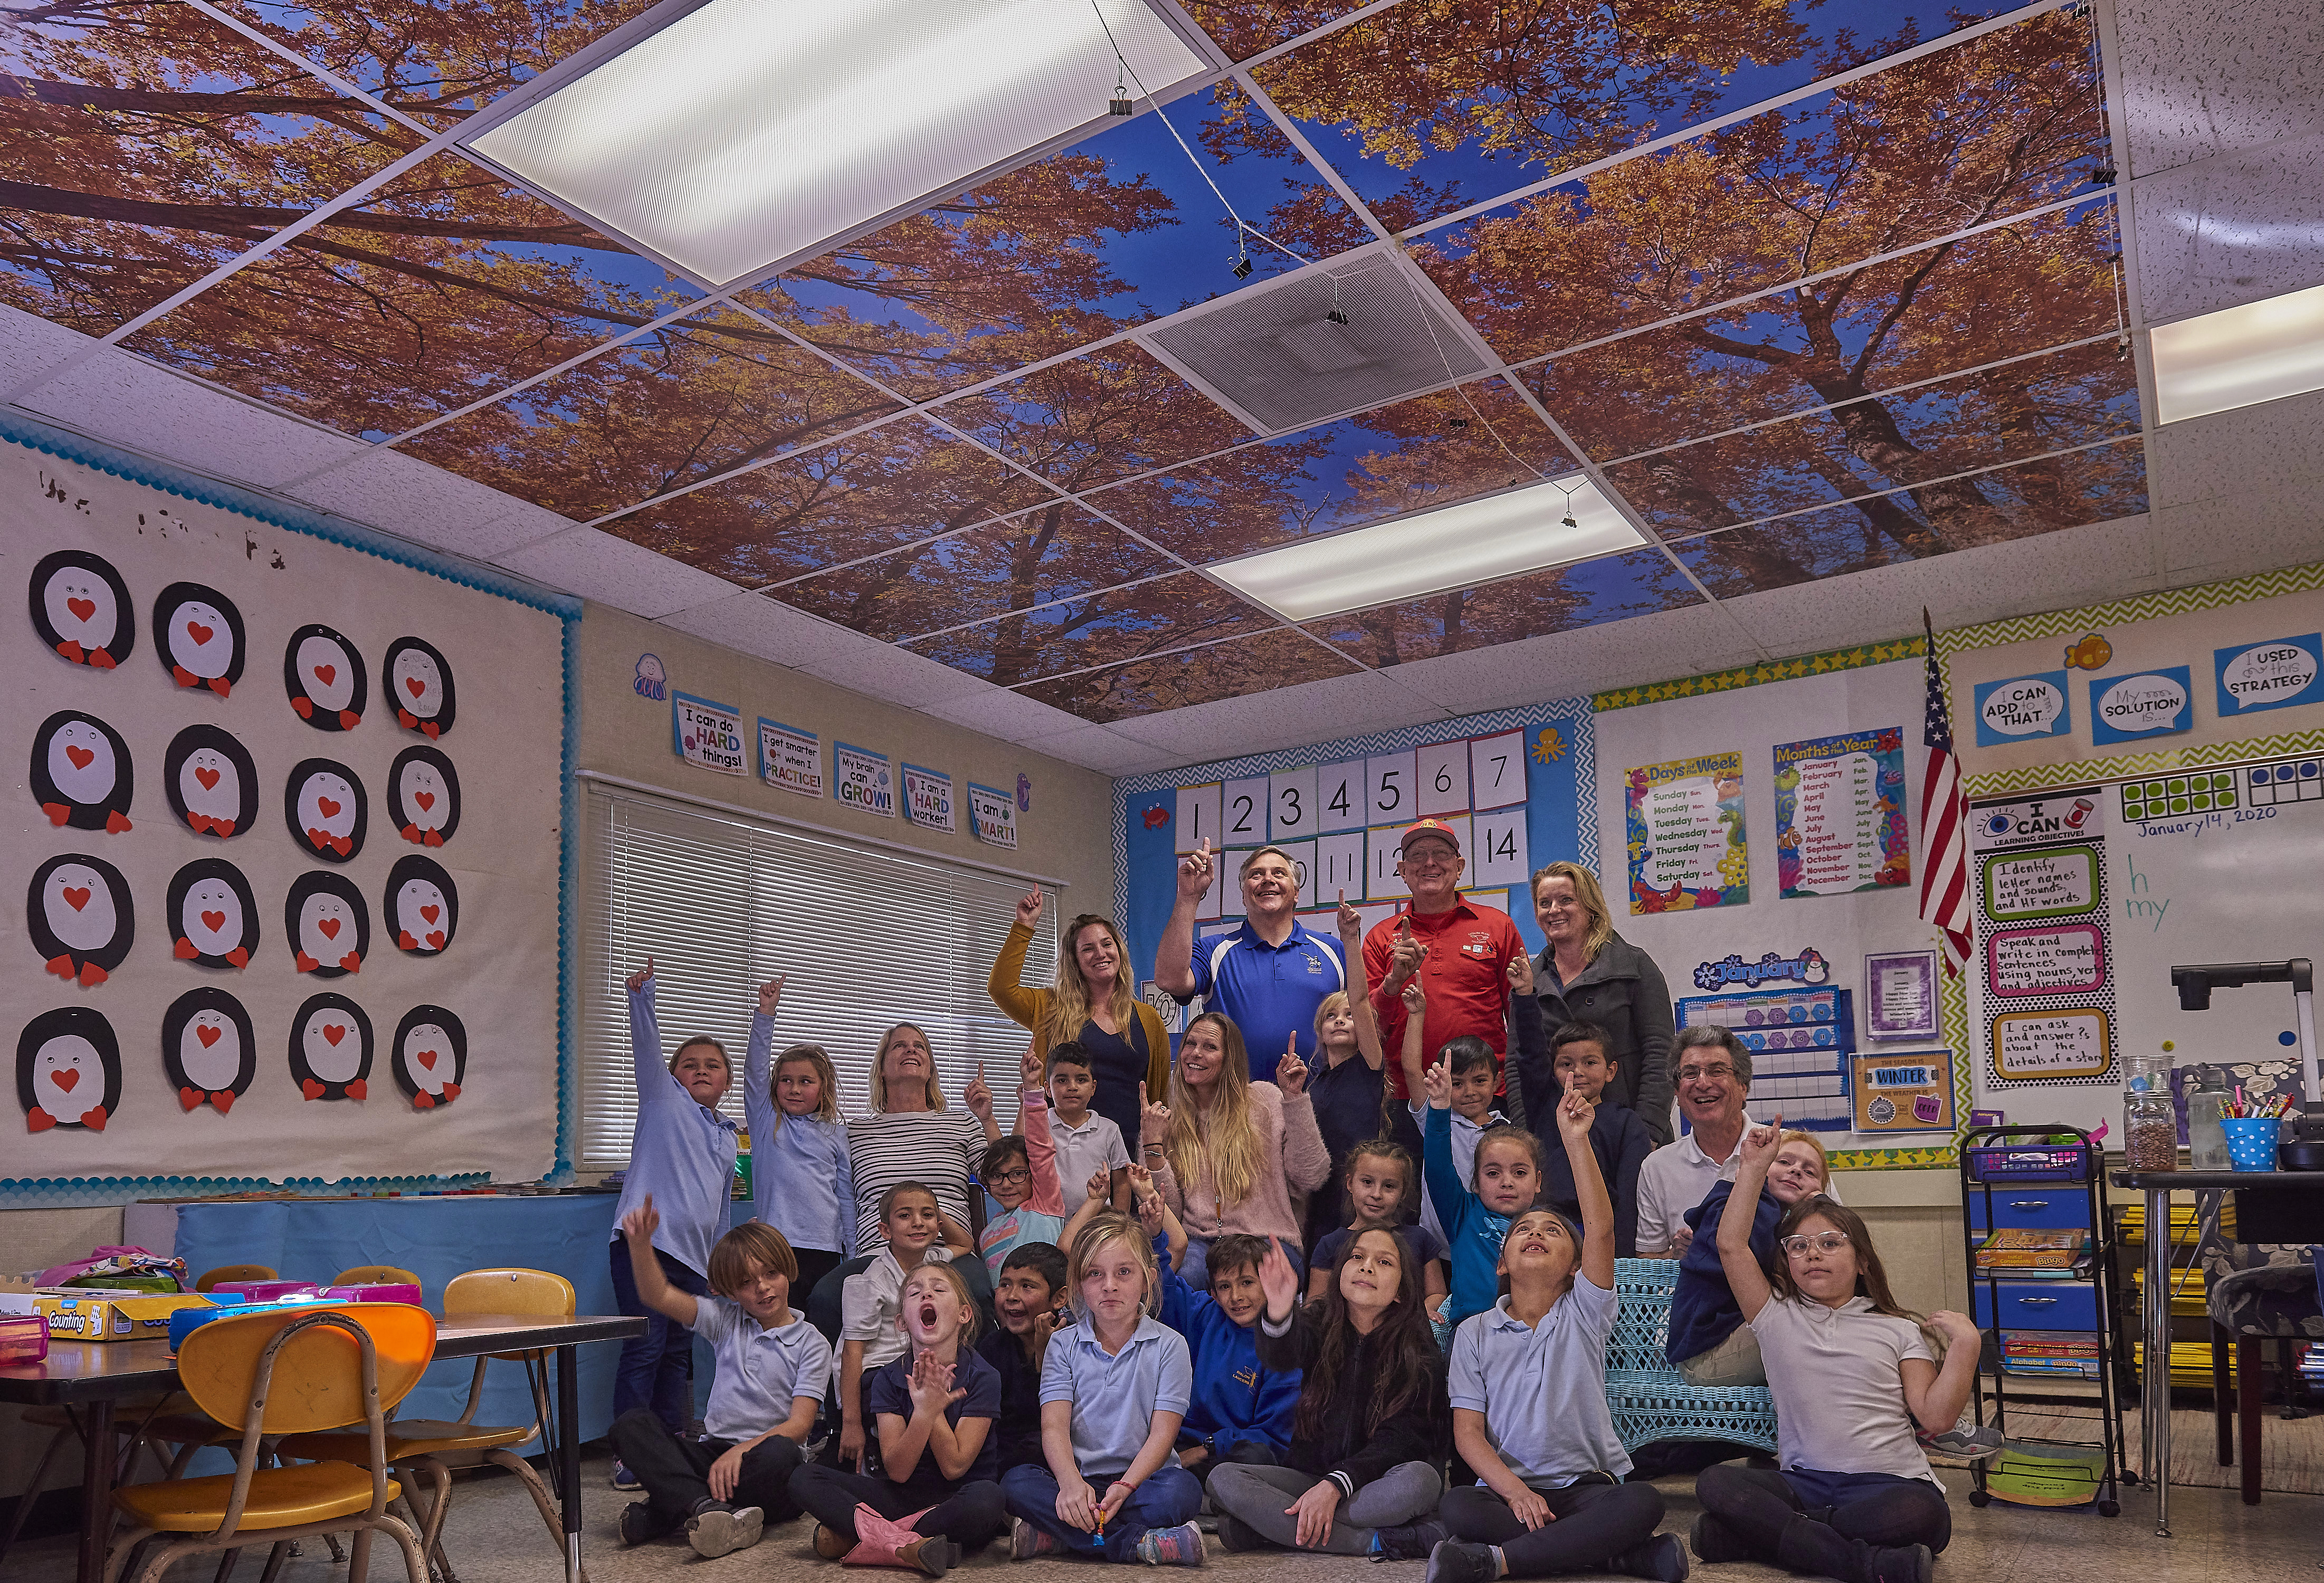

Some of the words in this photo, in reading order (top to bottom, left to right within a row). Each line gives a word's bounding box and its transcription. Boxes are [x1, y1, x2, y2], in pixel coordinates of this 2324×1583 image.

[2245, 653, 2251, 665] I
[2258, 649, 2298, 663] USED
[2271, 661, 2300, 675] this
[2230, 673, 2312, 693] STRATEGY
[2002, 691, 2006, 702] I
[2013, 686, 2046, 701] CAN
[2117, 690, 2140, 705] My
[1986, 703, 2018, 717] ADD
[2022, 700, 2035, 711] to
[2106, 698, 2179, 717] SOLUTION
[686, 709, 692, 721] I
[697, 714, 716, 728] can
[720, 719, 733, 732] do
[2001, 710, 2051, 726] THAT...
[697, 727, 740, 751] HARD
[764, 734, 768, 743] I
[770, 738, 784, 748] get
[786, 743, 817, 756] smarter
[702, 748, 742, 767] things!
[1776, 745, 1830, 762] Months
[1842, 738, 1879, 752] Year
[785, 756, 805, 768] when
[807, 760, 812, 769] I
[843, 757, 854, 770] My
[856, 761, 875, 774] brain
[1650, 766, 1685, 780] Days
[1696, 756, 1738, 773] Week
[1802, 760, 1838, 770] January
[766, 762, 821, 788] PRACTICE!
[850, 771, 868, 784] can
[1435, 764, 1451, 793] 6
[1490, 755, 1507, 787] 7
[1803, 770, 1843, 781] February
[920, 780, 925, 790] I
[928, 784, 939, 794] am
[1377, 771, 1400, 810] 5
[1803, 781, 1830, 791] March
[841, 781, 891, 809] GROW!
[915, 793, 949, 813] HARD
[1328, 779, 1351, 817] 4
[1653, 790, 1687, 802] Sunday
[1804, 792, 1824, 802] April
[974, 799, 980, 812] I
[1280, 788, 1302, 826] 3
[1654, 803, 1689, 815] Monday
[2031, 803, 2043, 817] I
[913, 809, 948, 825] worker!
[1194, 804, 1198, 839] 1
[1231, 796, 1253, 832] 2
[2136, 821, 2203, 837] January
[2234, 807, 2277, 822] 2020
[976, 818, 1014, 841] SMART!
[1654, 817, 1692, 828] Tuesday
[1805, 824, 1822, 833] July
[2017, 817, 2060, 835] CAN
[1655, 828, 1707, 842] Wednesday
[1806, 833, 1835, 844] August
[1994, 836, 2036, 846] LEARNING
[2038, 830, 2084, 841] OBJECTIVES
[1487, 827, 1517, 863] 14
[1655, 844, 1699, 855] Thursday
[1806, 843, 1854, 854] September
[1656, 859, 1685, 869] Friday
[1807, 854, 1842, 864] October
[1999, 858, 2055, 875] Identify
[1329, 854, 1351, 884] 11
[1656, 871, 1700, 882] Saturday
[1807, 864, 1850, 874] November
[2128, 854, 2148, 894] h
[1807, 874, 1850, 885] December
[1999, 878, 2031, 889] letter
[2037, 871, 2077, 884] names
[2000, 889, 2020, 899] and
[2024, 882, 2066, 894] sounds,
[1995, 899, 2015, 910] and
[2021, 898, 2036, 908] HF
[2042, 892, 2080, 906] words
[2126, 899, 2170, 933] my
[2000, 937, 2035, 950] Speak
[2039, 935, 2061, 946] and
[1998, 949, 2032, 960] write
[2055, 945, 2103, 959] complete
[1716, 961, 1806, 983] January
[1997, 971, 2031, 981] using
[2037, 967, 2076, 978] nouns,
[2077, 965, 2104, 975] verbs
[2006, 1023, 2014, 1032] I
[2048, 1020, 2070, 1028] ask
[2006, 1033, 2028, 1042] and
[2079, 1027, 2090, 1040] ?s
[2005, 1042, 2039, 1052] about
[2007, 1055, 2046, 1067] details
[2050, 1053, 2060, 1063] of
[2076, 1051, 2104, 1066] story
[1877, 1070, 1926, 1083] WINTER
[2037, 1256, 2064, 1265] Bingo
[49, 1311, 85, 1332] Counting
